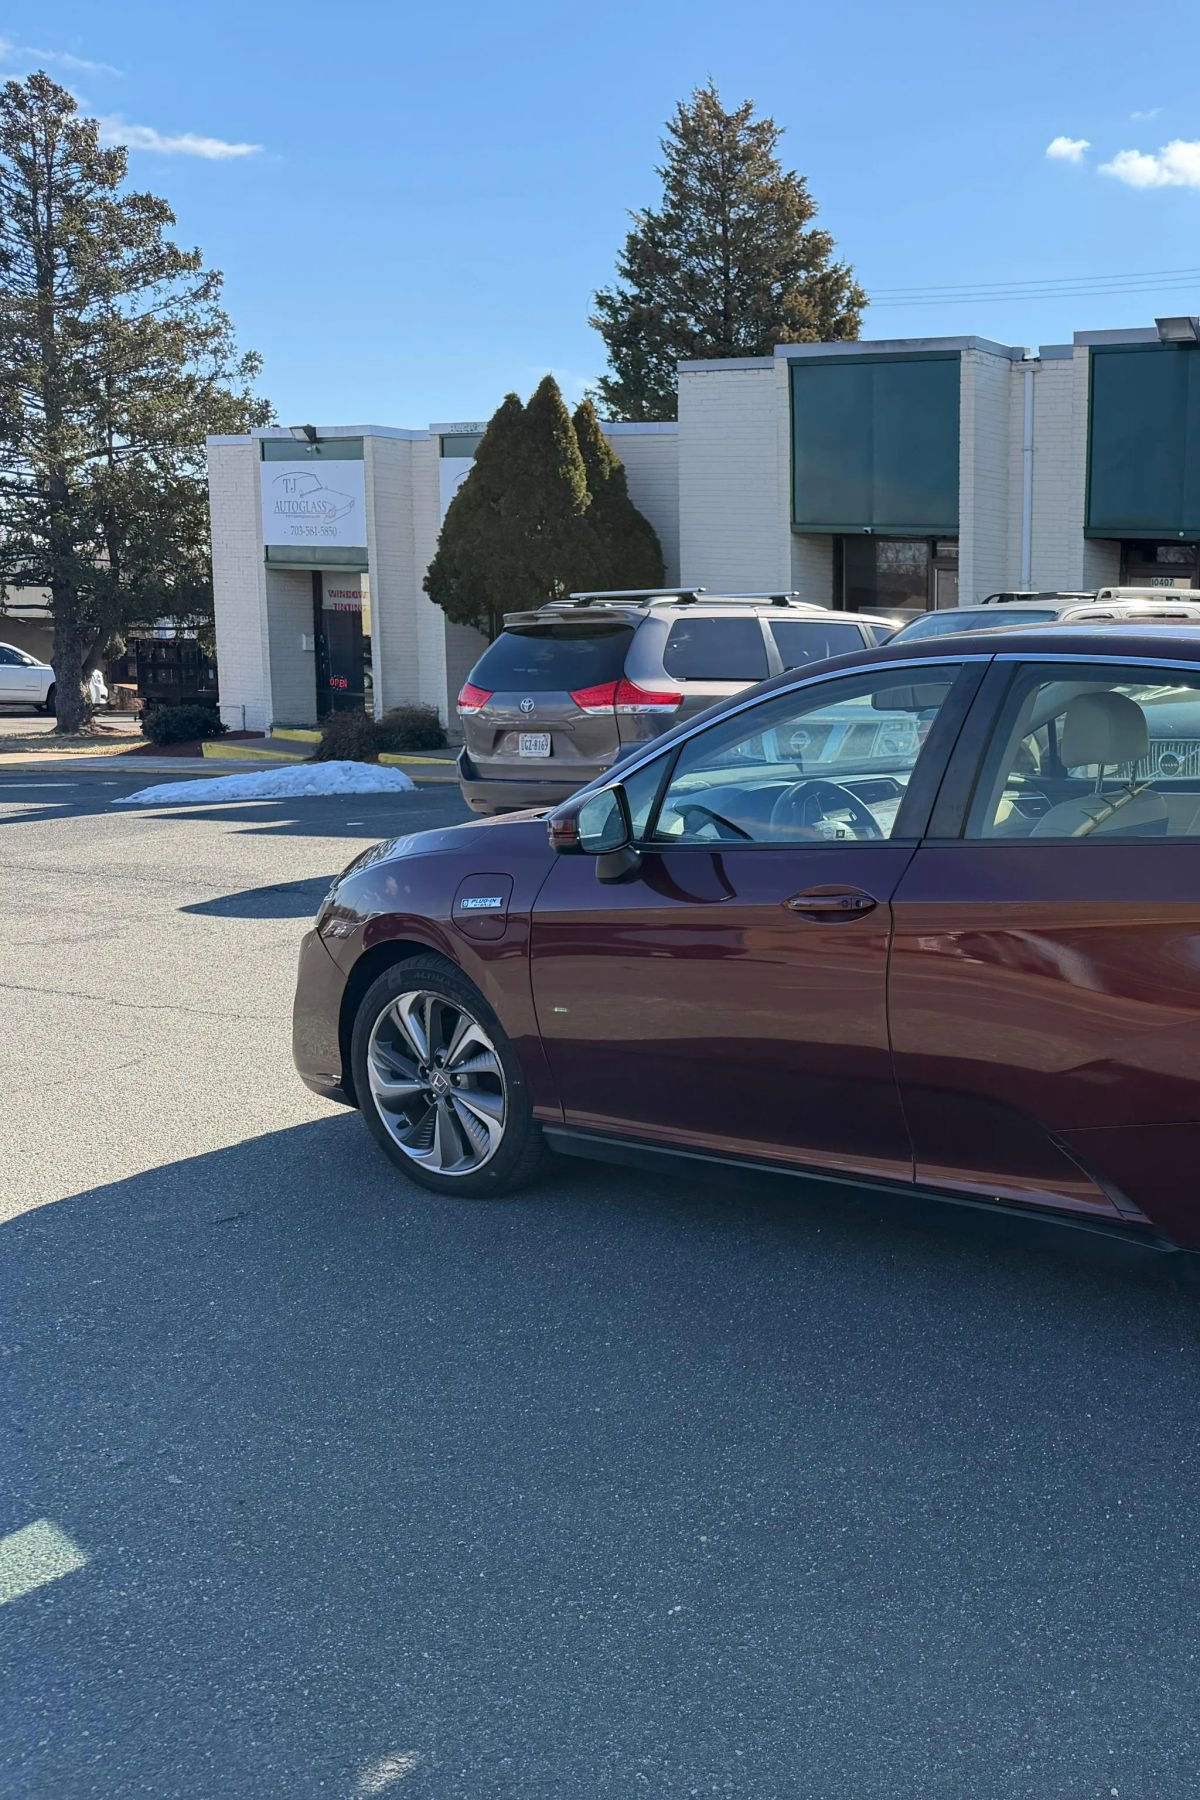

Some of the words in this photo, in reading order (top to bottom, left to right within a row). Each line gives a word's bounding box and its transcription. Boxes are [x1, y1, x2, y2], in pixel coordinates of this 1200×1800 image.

[282, 478, 297, 494] TJ
[274, 500, 328, 513] AUTOGLASS
[329, 678, 349, 688] OPEN
